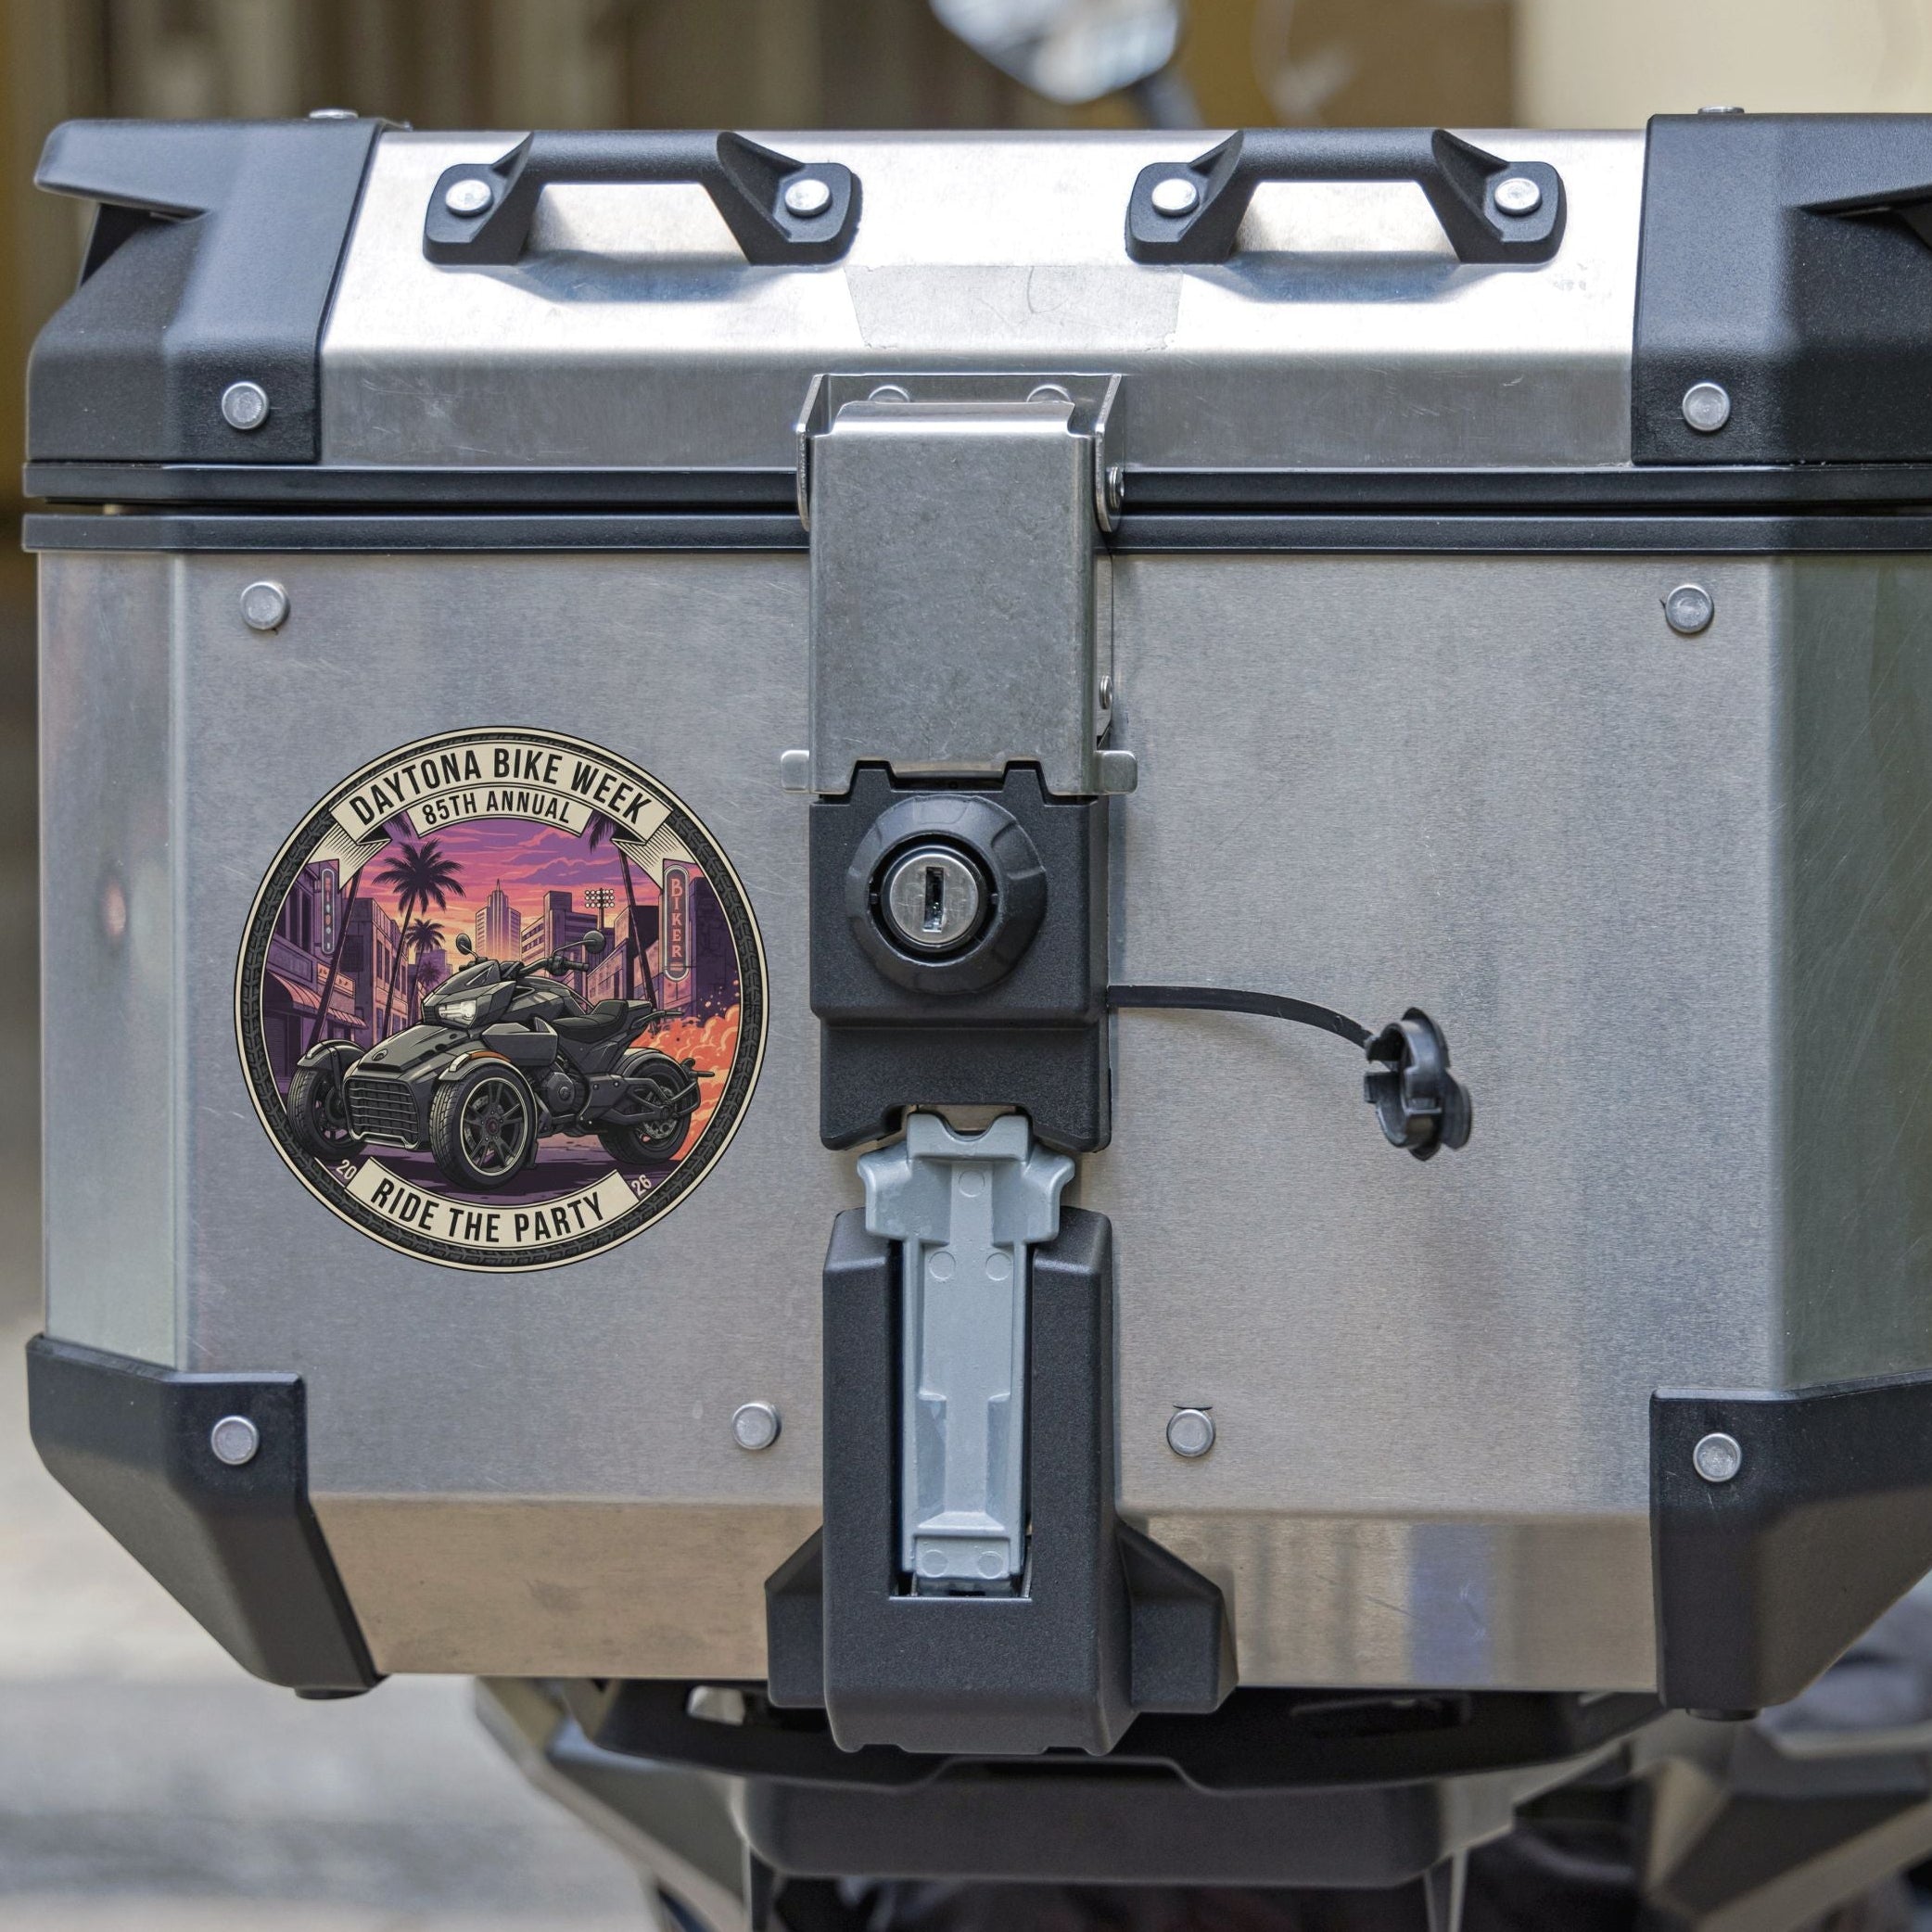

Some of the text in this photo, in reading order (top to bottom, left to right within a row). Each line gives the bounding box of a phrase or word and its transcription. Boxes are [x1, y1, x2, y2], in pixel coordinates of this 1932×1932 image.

[350, 748, 652, 826] DAYTONA BIKE WEEK
[422, 791, 570, 825] 85TH ANNUAL
[671, 878, 683, 958] BIKER
[336, 1159, 357, 1180] 20
[631, 1174, 653, 1196] 26
[371, 1177, 604, 1243] RIDE THE PARTY
